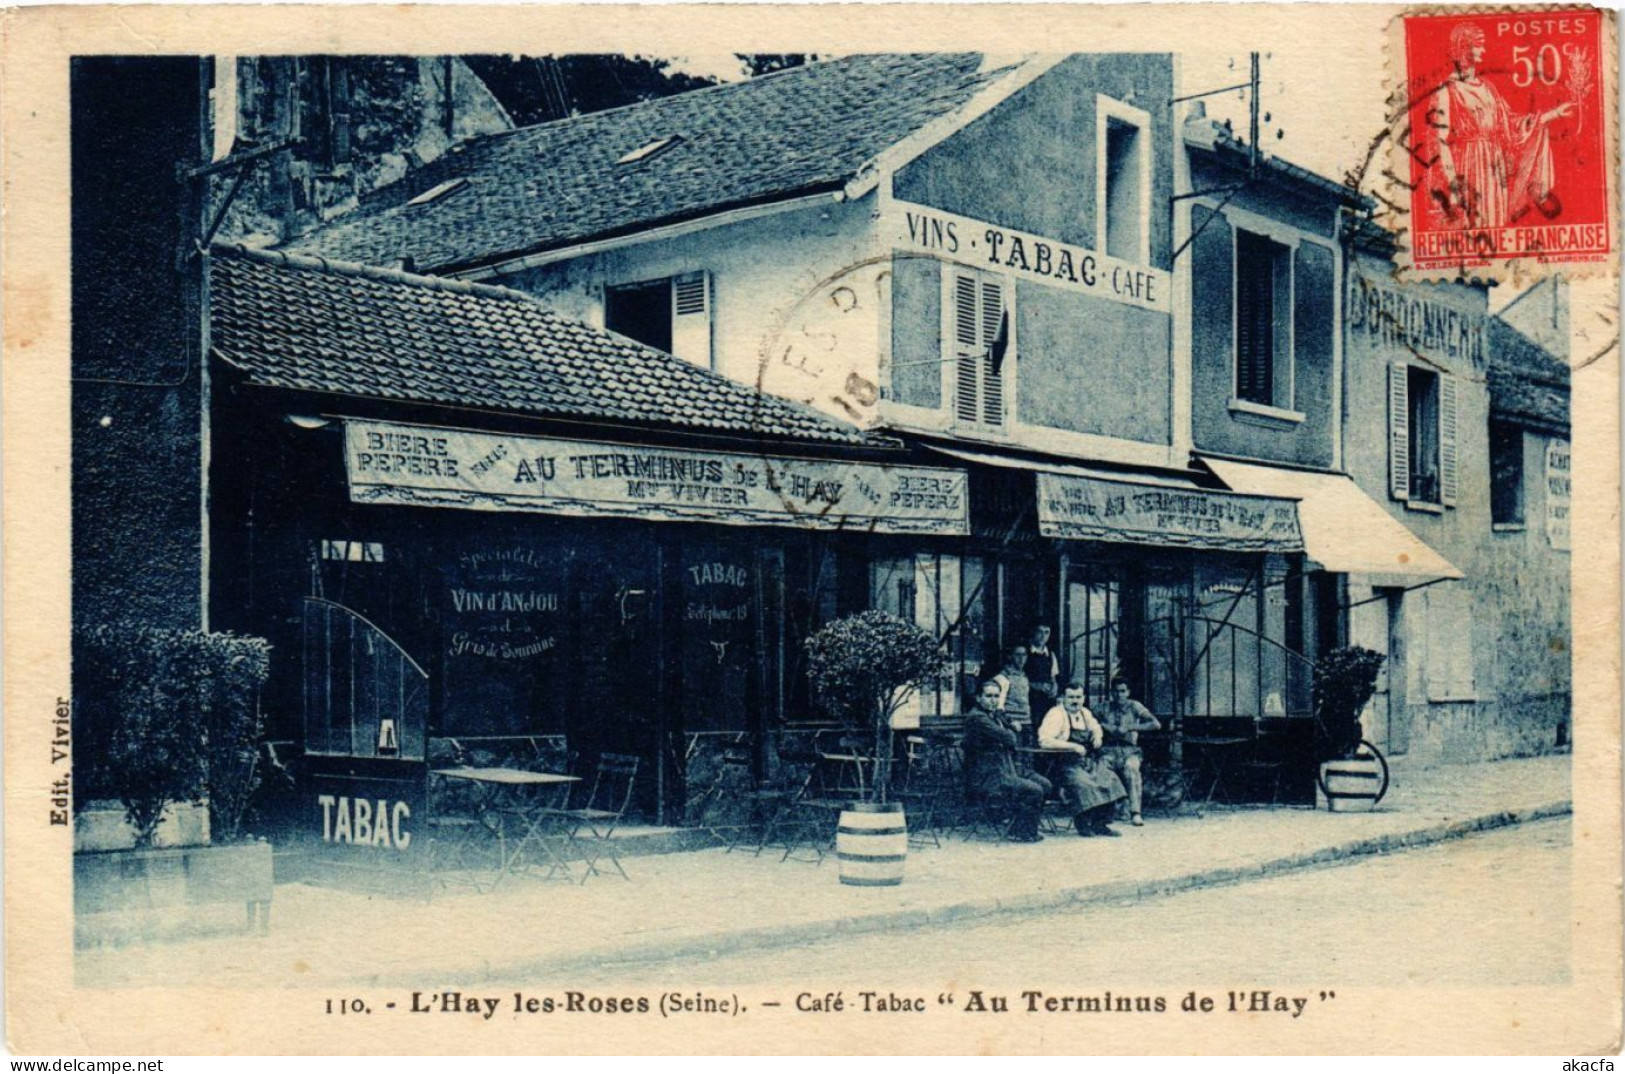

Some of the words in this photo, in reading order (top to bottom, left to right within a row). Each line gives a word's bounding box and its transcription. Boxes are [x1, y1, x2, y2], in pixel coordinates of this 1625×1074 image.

[1497, 18, 1587, 37] POSTES
[906, 211, 959, 253] VINS
[984, 229, 1097, 287] TABAC
[1514, 226, 1605, 251] FRANÇAISE
[366, 431, 449, 456] BIERE
[357, 453, 459, 477] PEPERE
[513, 456, 557, 483] AU
[569, 453, 724, 484] TERMINUS
[668, 483, 749, 505] VIVIER
[897, 475, 953, 494] BIERE
[889, 491, 960, 510] PEPERE
[686, 561, 748, 588] TABAC
[450, 588, 484, 613] VIN
[486, 588, 559, 613] d'ANJOU
[318, 794, 412, 850] TABAC
